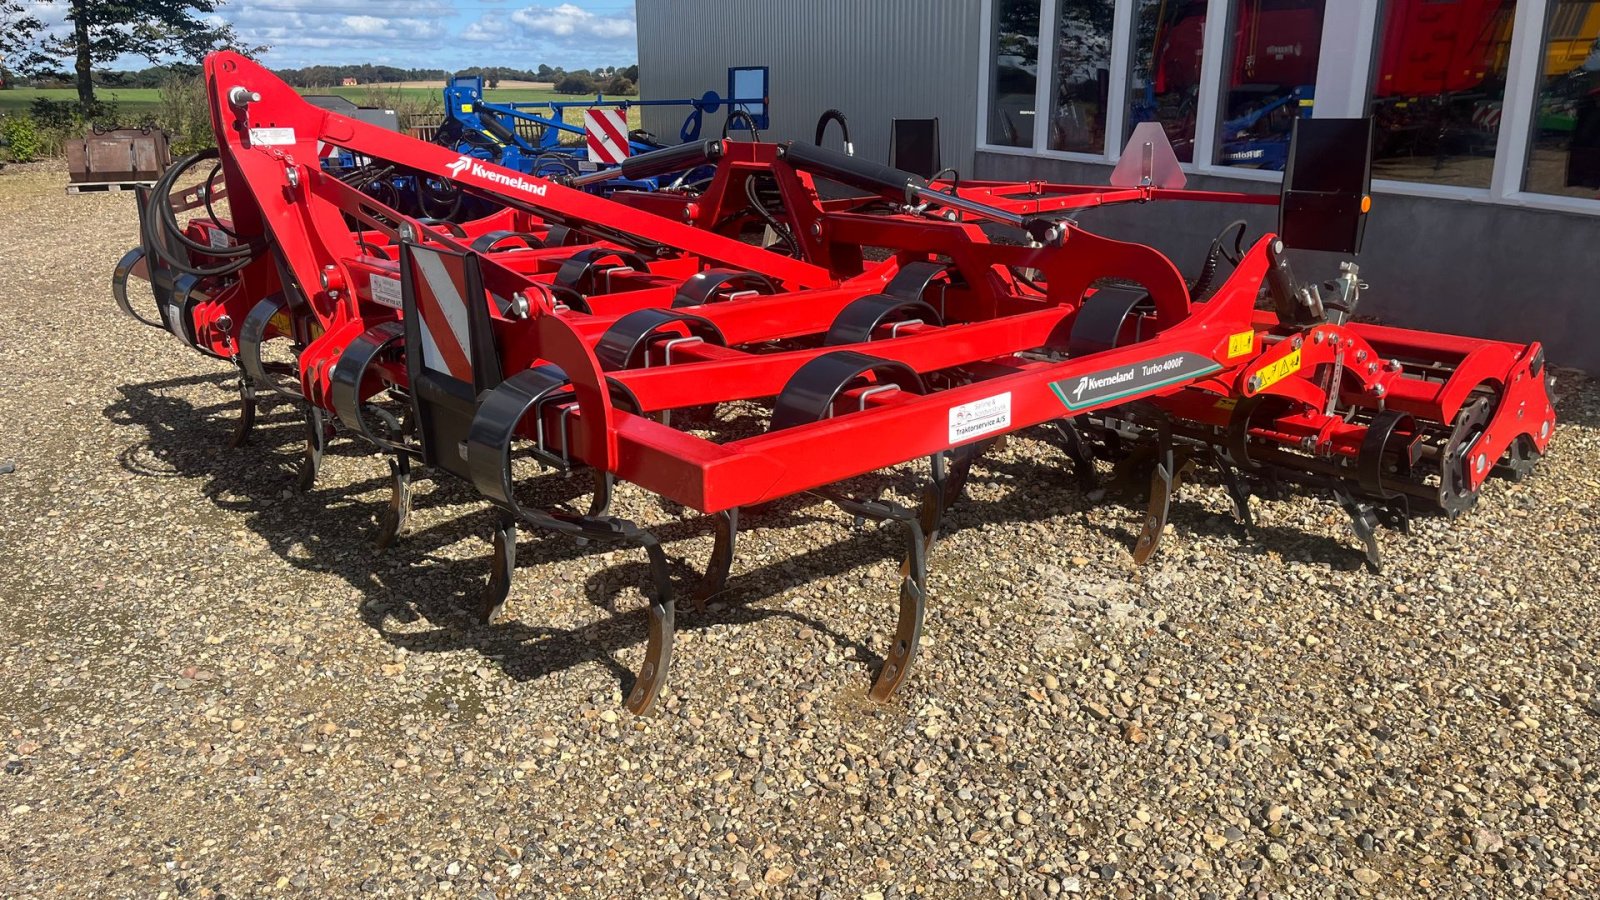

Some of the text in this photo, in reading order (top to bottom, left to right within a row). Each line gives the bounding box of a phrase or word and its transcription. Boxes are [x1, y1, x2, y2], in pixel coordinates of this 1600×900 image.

[472, 163, 547, 197] Kverneland
[1088, 357, 1184, 390] Kverneland Turbo 4000F
[956, 415, 1006, 436] Traktorservice A/S
